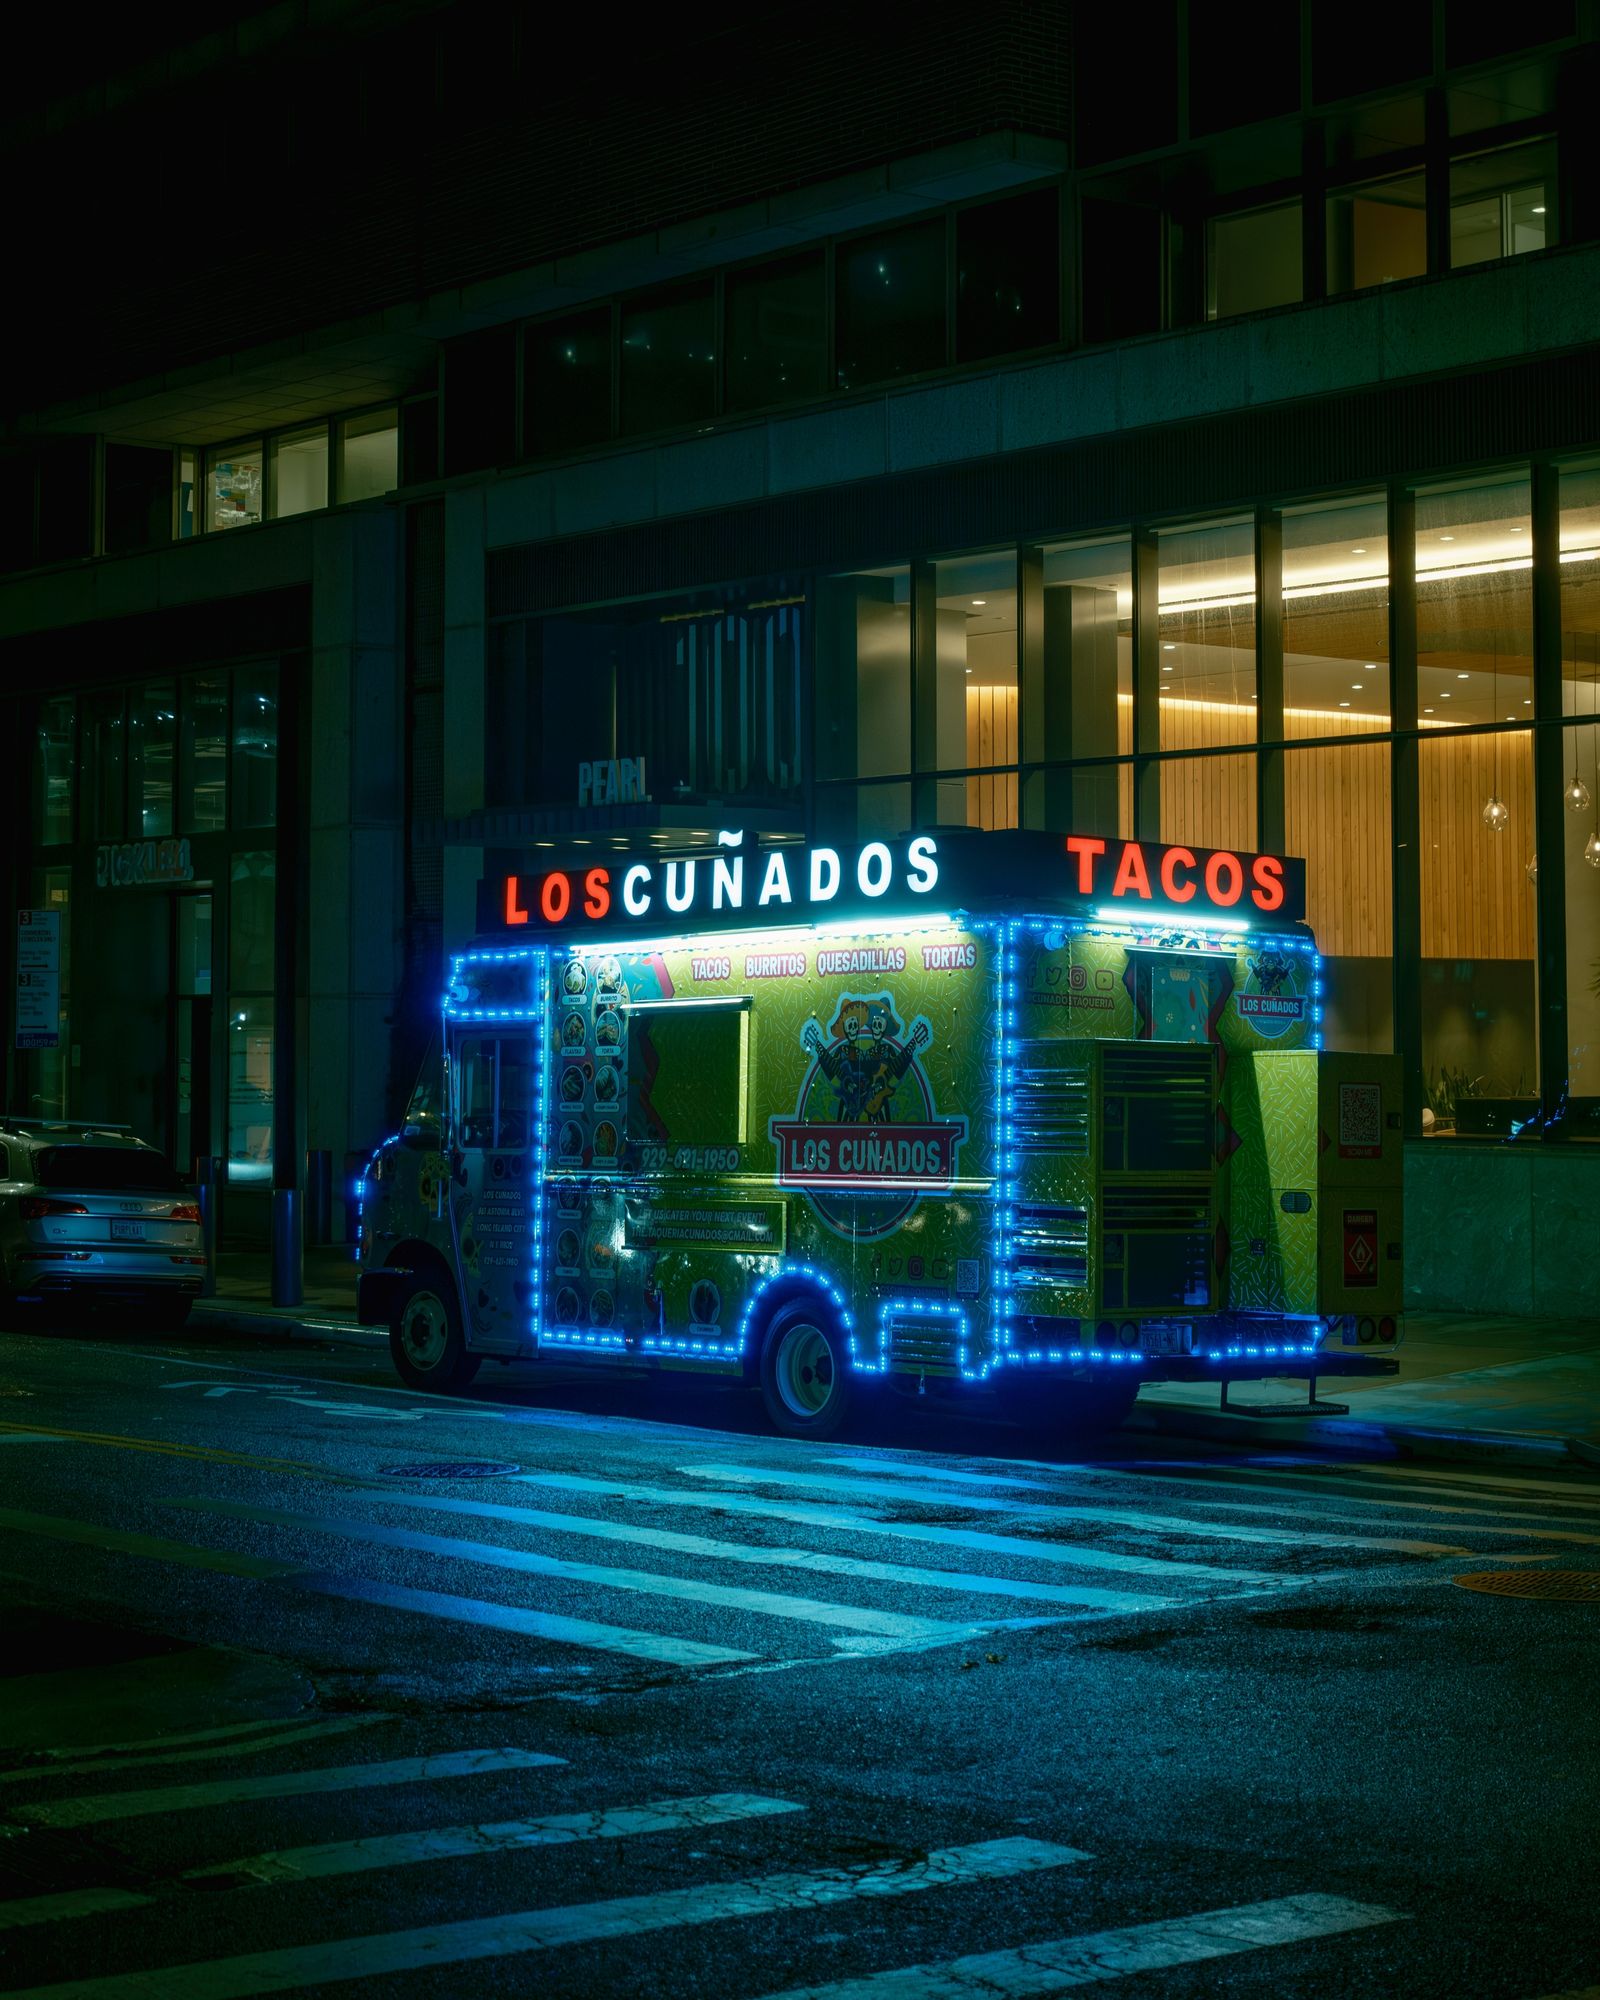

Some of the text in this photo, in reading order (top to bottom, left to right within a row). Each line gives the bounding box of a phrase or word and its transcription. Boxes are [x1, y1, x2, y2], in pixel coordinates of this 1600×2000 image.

[578, 756, 652, 808] PEARL
[505, 829, 939, 925] LOS CUÑADOS
[1067, 837, 1285, 911] TACOS
[692, 945, 976, 980] TACOS BURRITOS QUESADILLAS TORTAS
[1242, 998, 1258, 1012] LOS
[641, 1147, 740, 1171] 929-621-1950
[791, 1131, 942, 1174] LOS CUÑADOS
[653, 1210, 664, 1221] US
[692, 1211, 712, 1222] YOUR
[715, 1211, 736, 1223] NEXT
